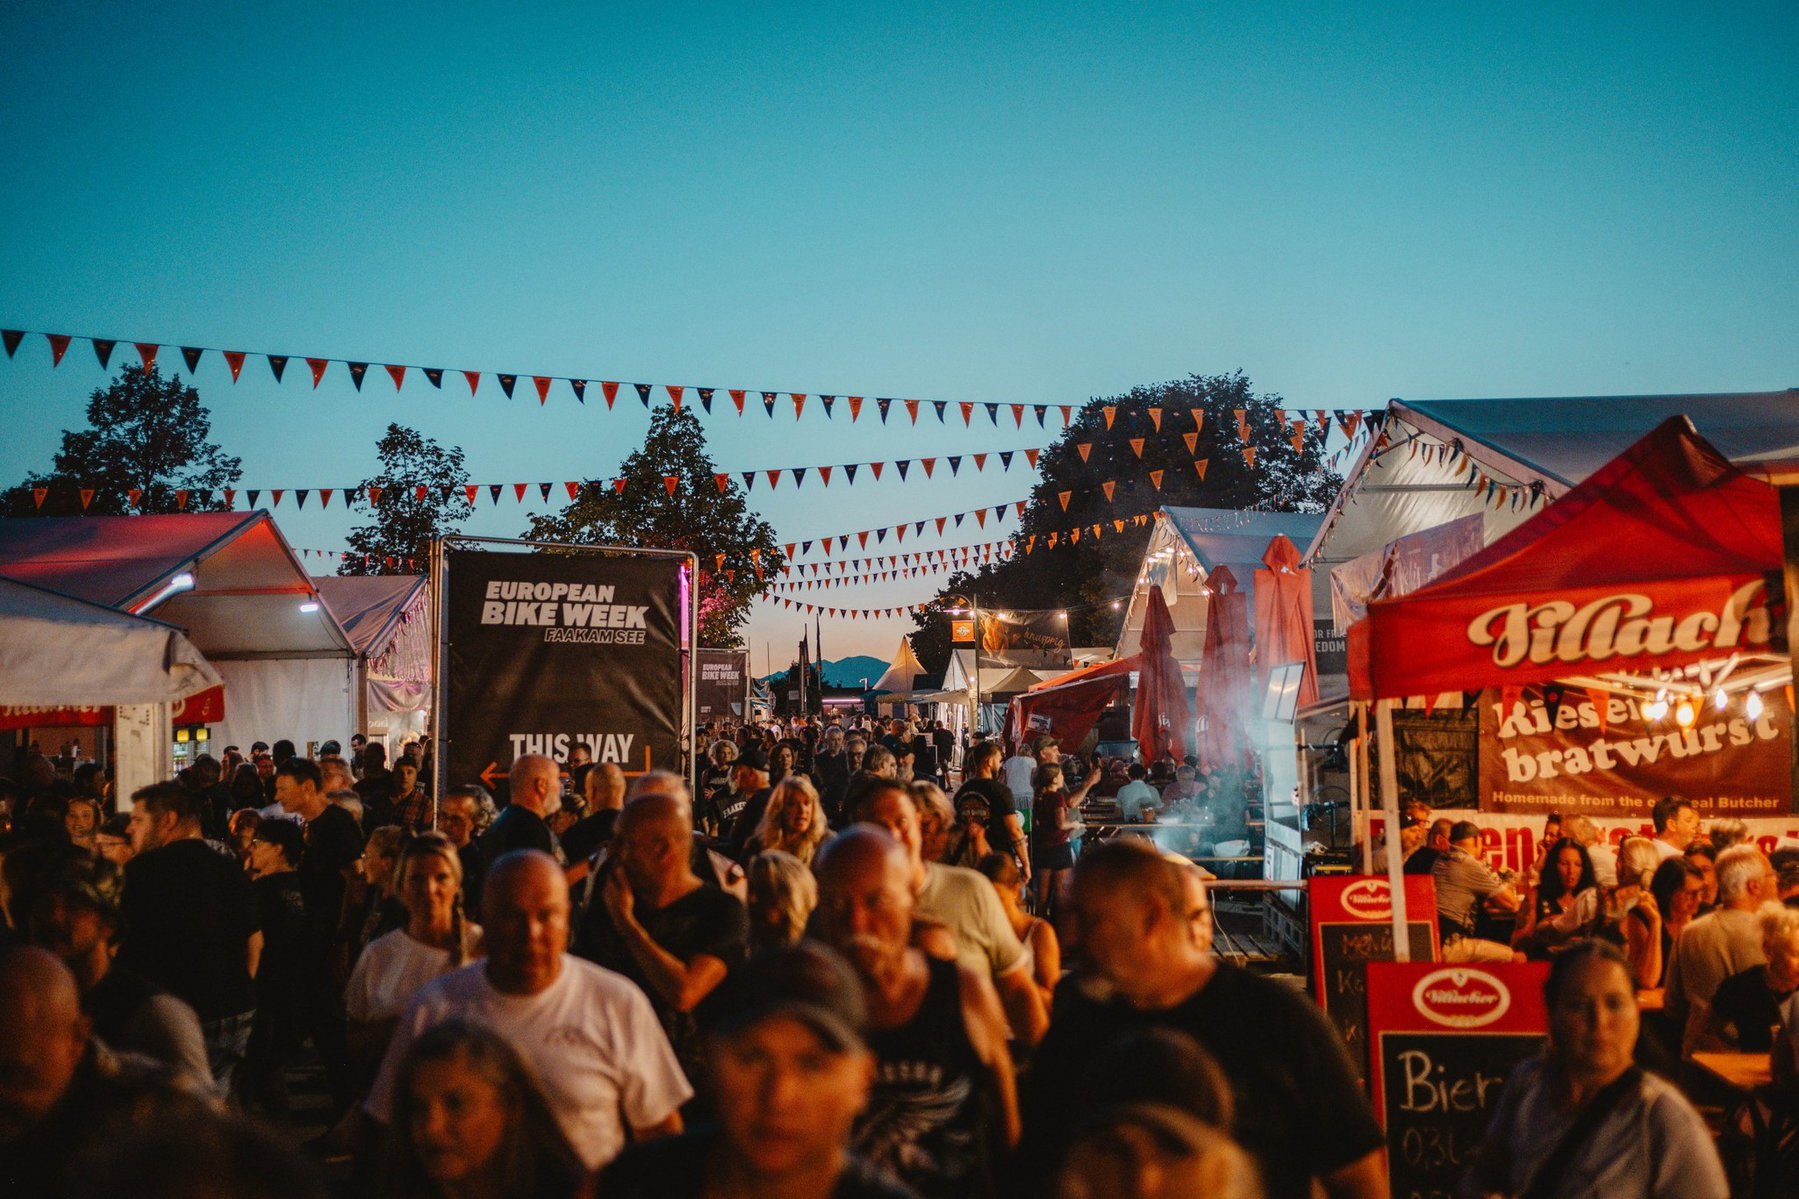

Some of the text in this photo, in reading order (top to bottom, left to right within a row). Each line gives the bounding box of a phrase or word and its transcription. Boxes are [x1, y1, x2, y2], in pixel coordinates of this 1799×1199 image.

[485, 581, 615, 602] EUROPEAN
[480, 600, 649, 629] BIKE WEEK
[544, 628, 647, 645] FAAK AM SEE
[1315, 640, 1346, 652] EDOM
[702, 663, 733, 671] EUROPEAN
[702, 671, 740, 680] BIKE WEEK
[509, 733, 635, 764] THIS WAY
[1501, 710, 1780, 783] bratwurst
[1493, 791, 1577, 805] Homemade
[1580, 794, 1615, 806] from
[1619, 795, 1643, 807] the
[1691, 797, 1714, 809] eal
[1718, 797, 1780, 809] Butcher
[1397, 1050, 1504, 1113] Bier
